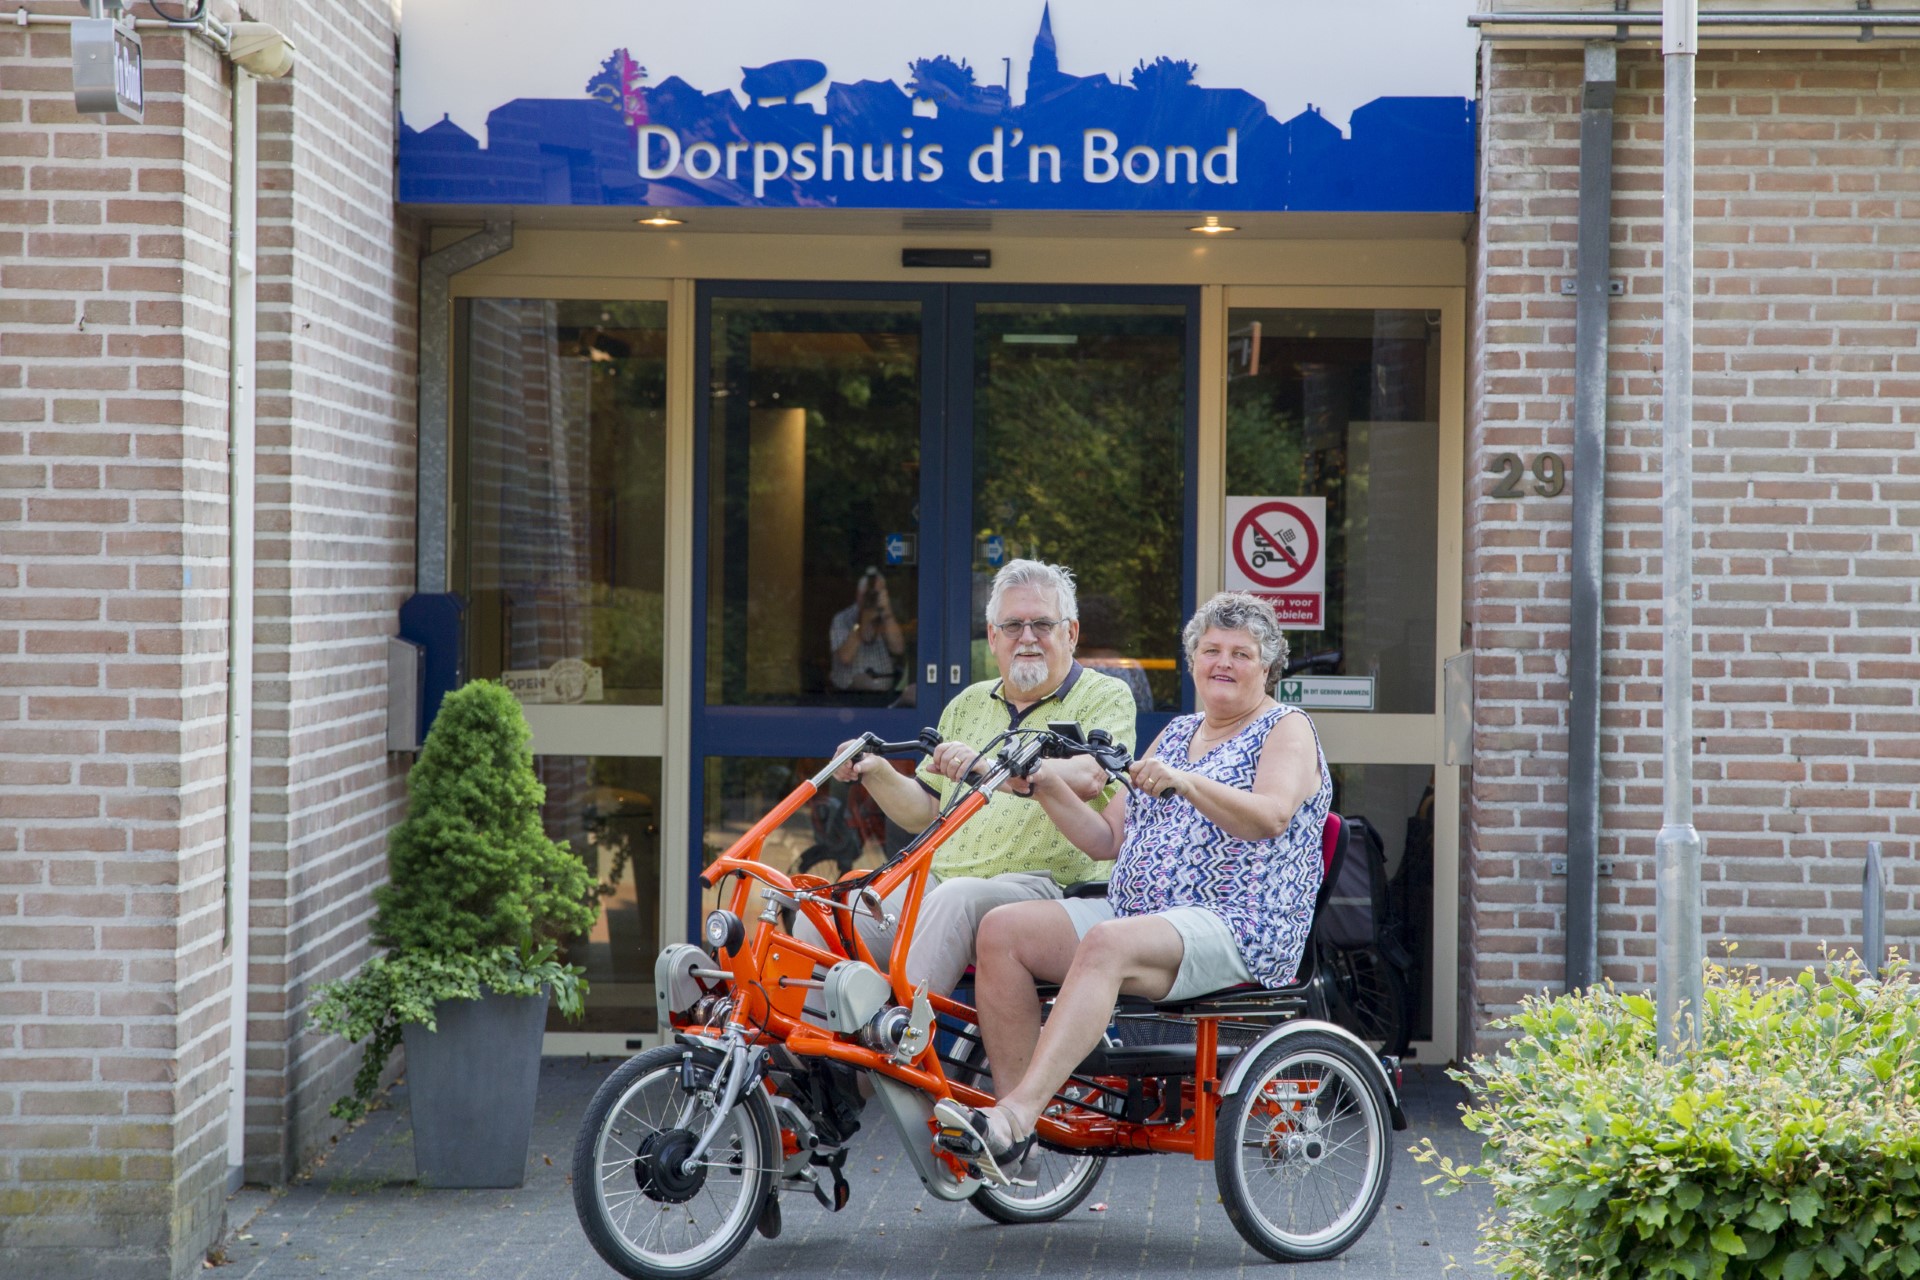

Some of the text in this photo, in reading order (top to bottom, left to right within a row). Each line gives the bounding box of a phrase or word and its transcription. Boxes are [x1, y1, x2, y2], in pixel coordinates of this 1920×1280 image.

[636, 124, 1239, 198] Dorpshuis d'n Bond
[1491, 451, 1565, 498] 29
[1289, 599, 1313, 607] voor
[1276, 610, 1313, 620] obielen
[506, 677, 546, 690] OPEN
